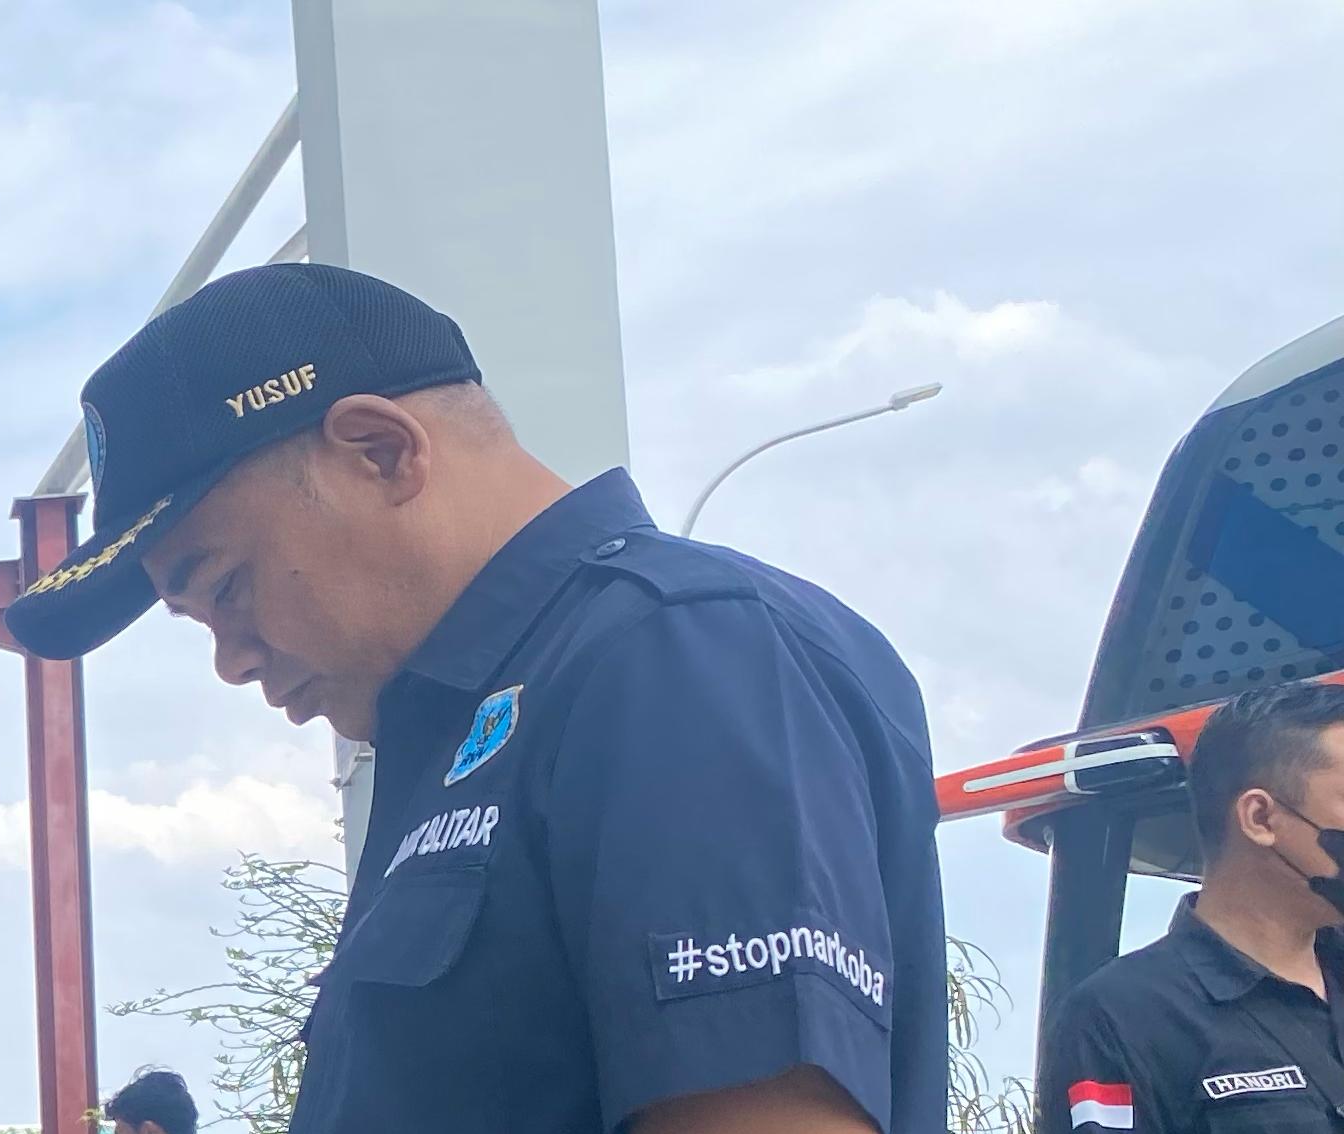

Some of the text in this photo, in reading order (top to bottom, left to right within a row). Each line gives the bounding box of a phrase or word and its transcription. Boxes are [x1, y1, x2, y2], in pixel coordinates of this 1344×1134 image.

[225, 363, 317, 419] YUSUF
[668, 926, 884, 1007] #stopnarkoba
[1214, 1072, 1295, 1093] HANDRI
